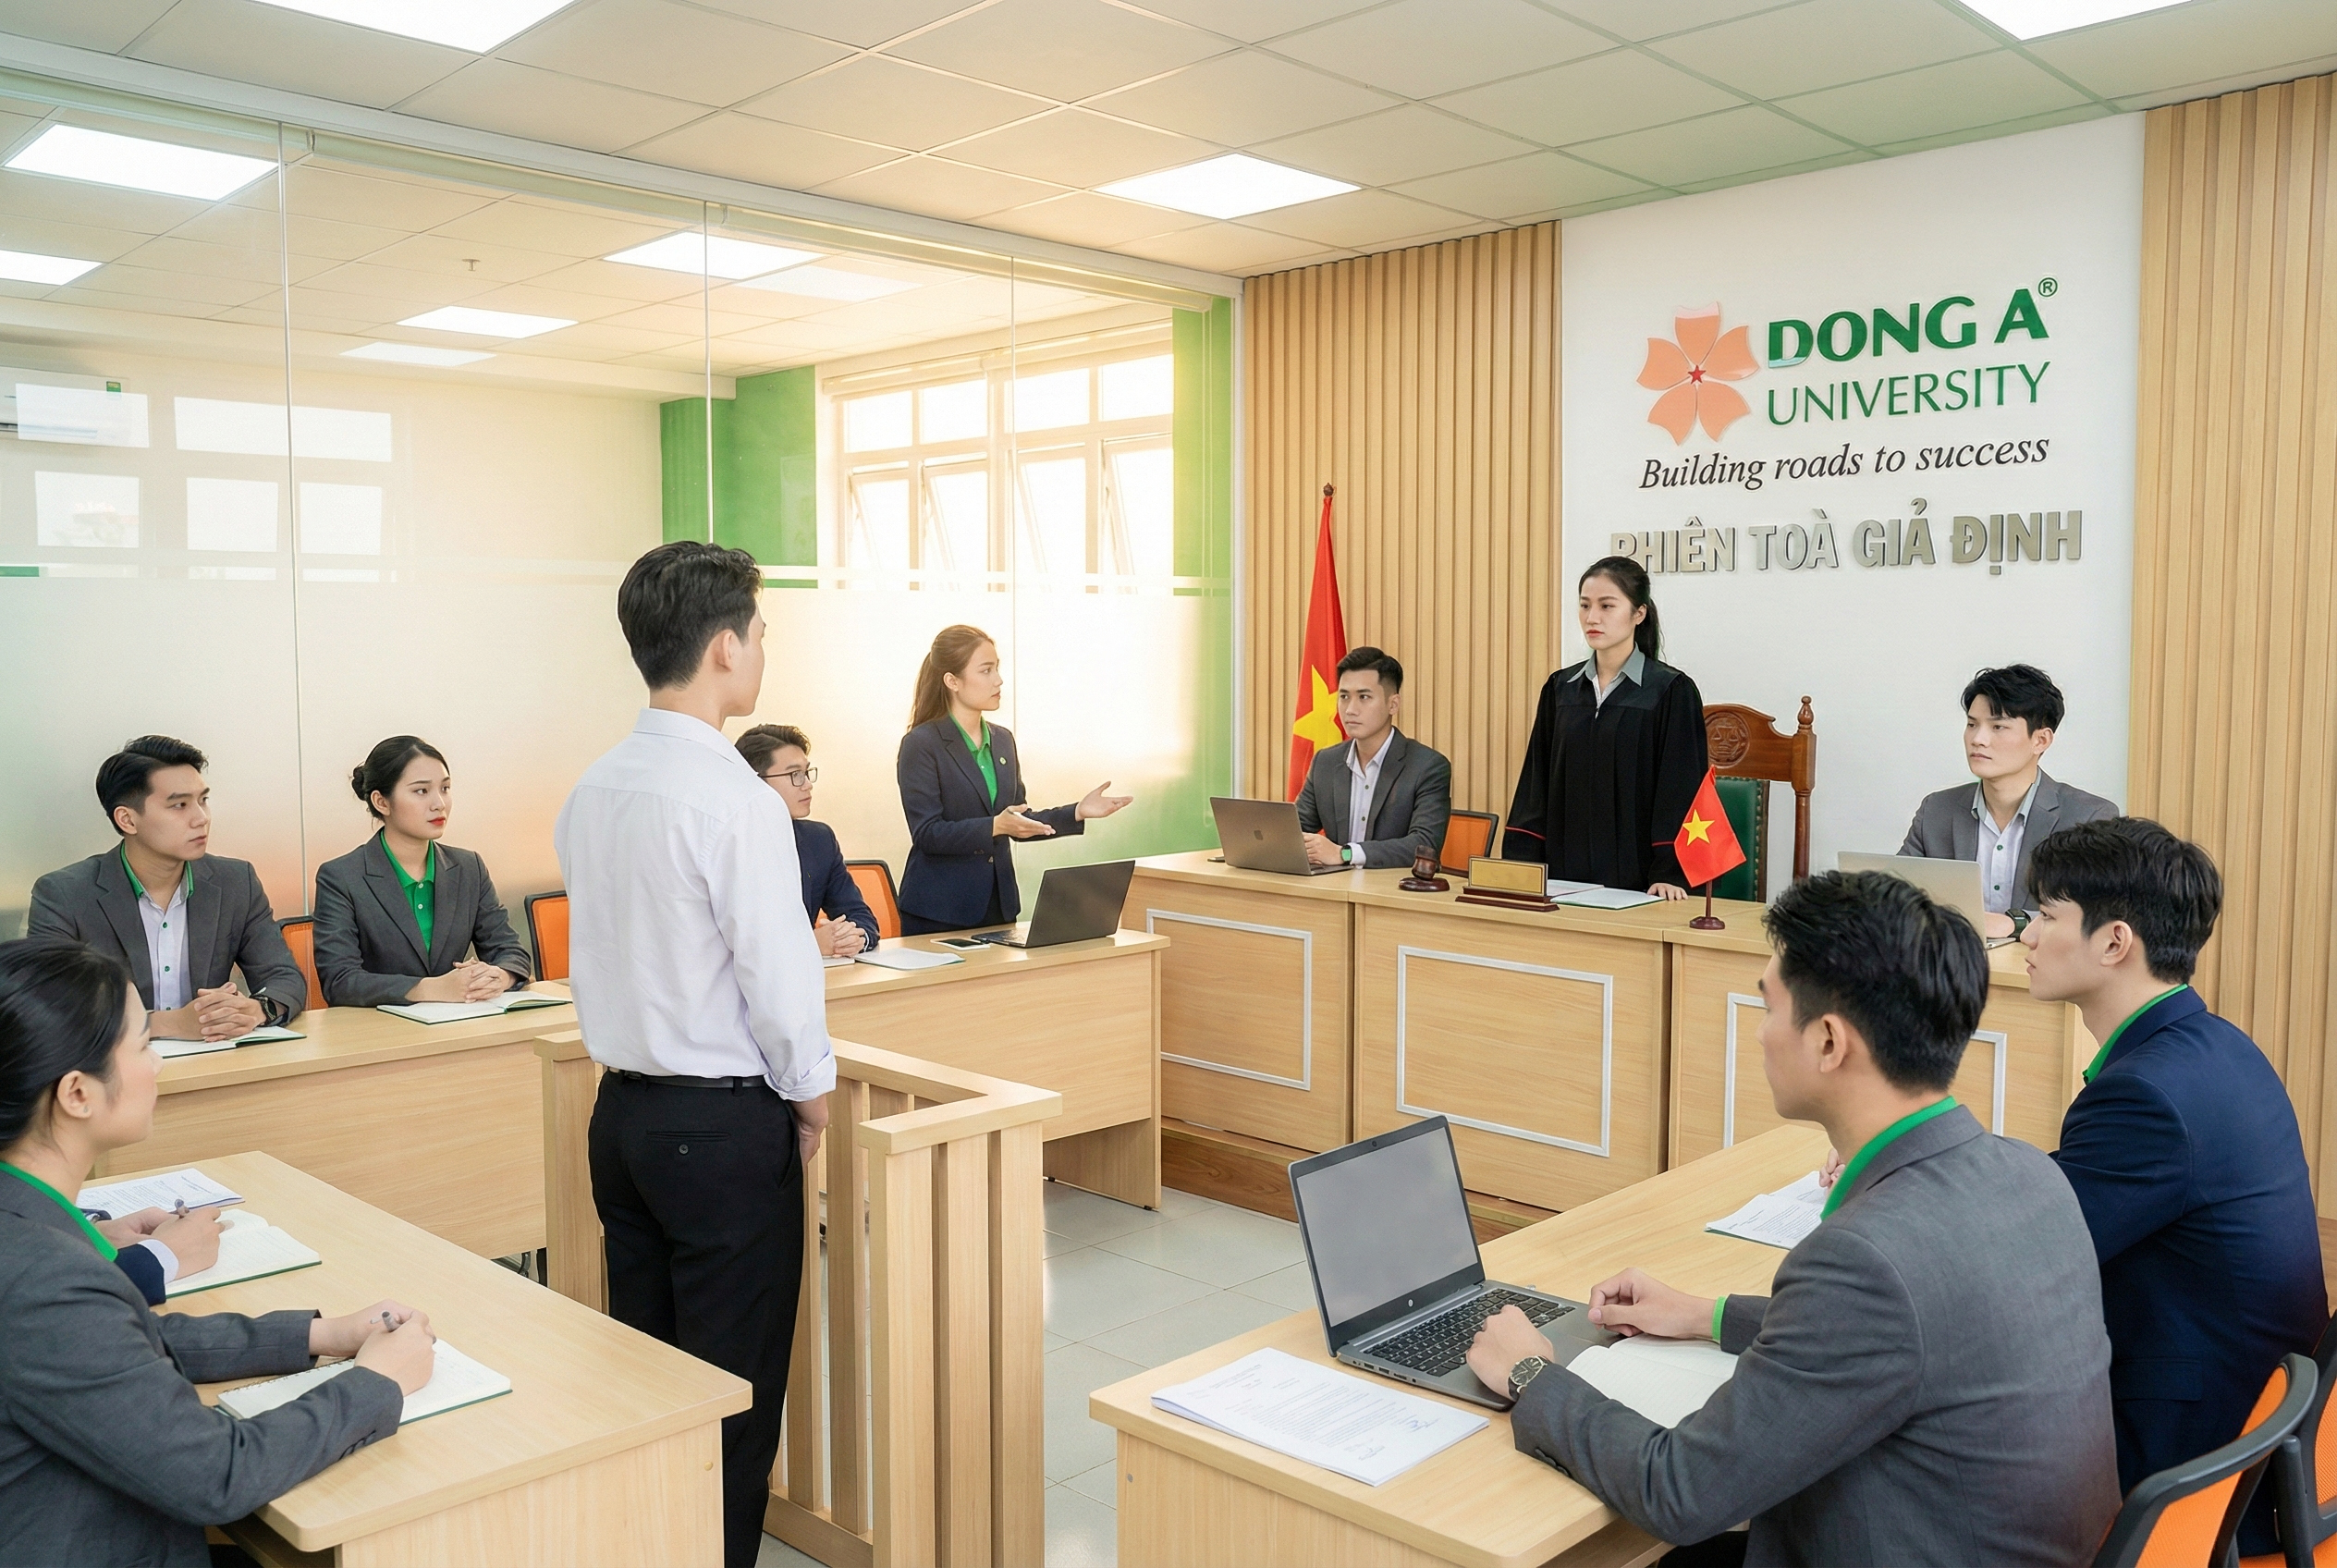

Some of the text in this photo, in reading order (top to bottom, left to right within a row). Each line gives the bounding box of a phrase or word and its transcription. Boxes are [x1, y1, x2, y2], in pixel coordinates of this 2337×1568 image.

[1768, 295, 1976, 369] DONG
[1768, 361, 2051, 425] UNIVERSITY
[1639, 438, 2050, 491] Building roads to success
[1747, 508, 1840, 571] TOÀ
[1853, 496, 1937, 568] GIẢ
[1949, 509, 2083, 576] ĐỊNH
